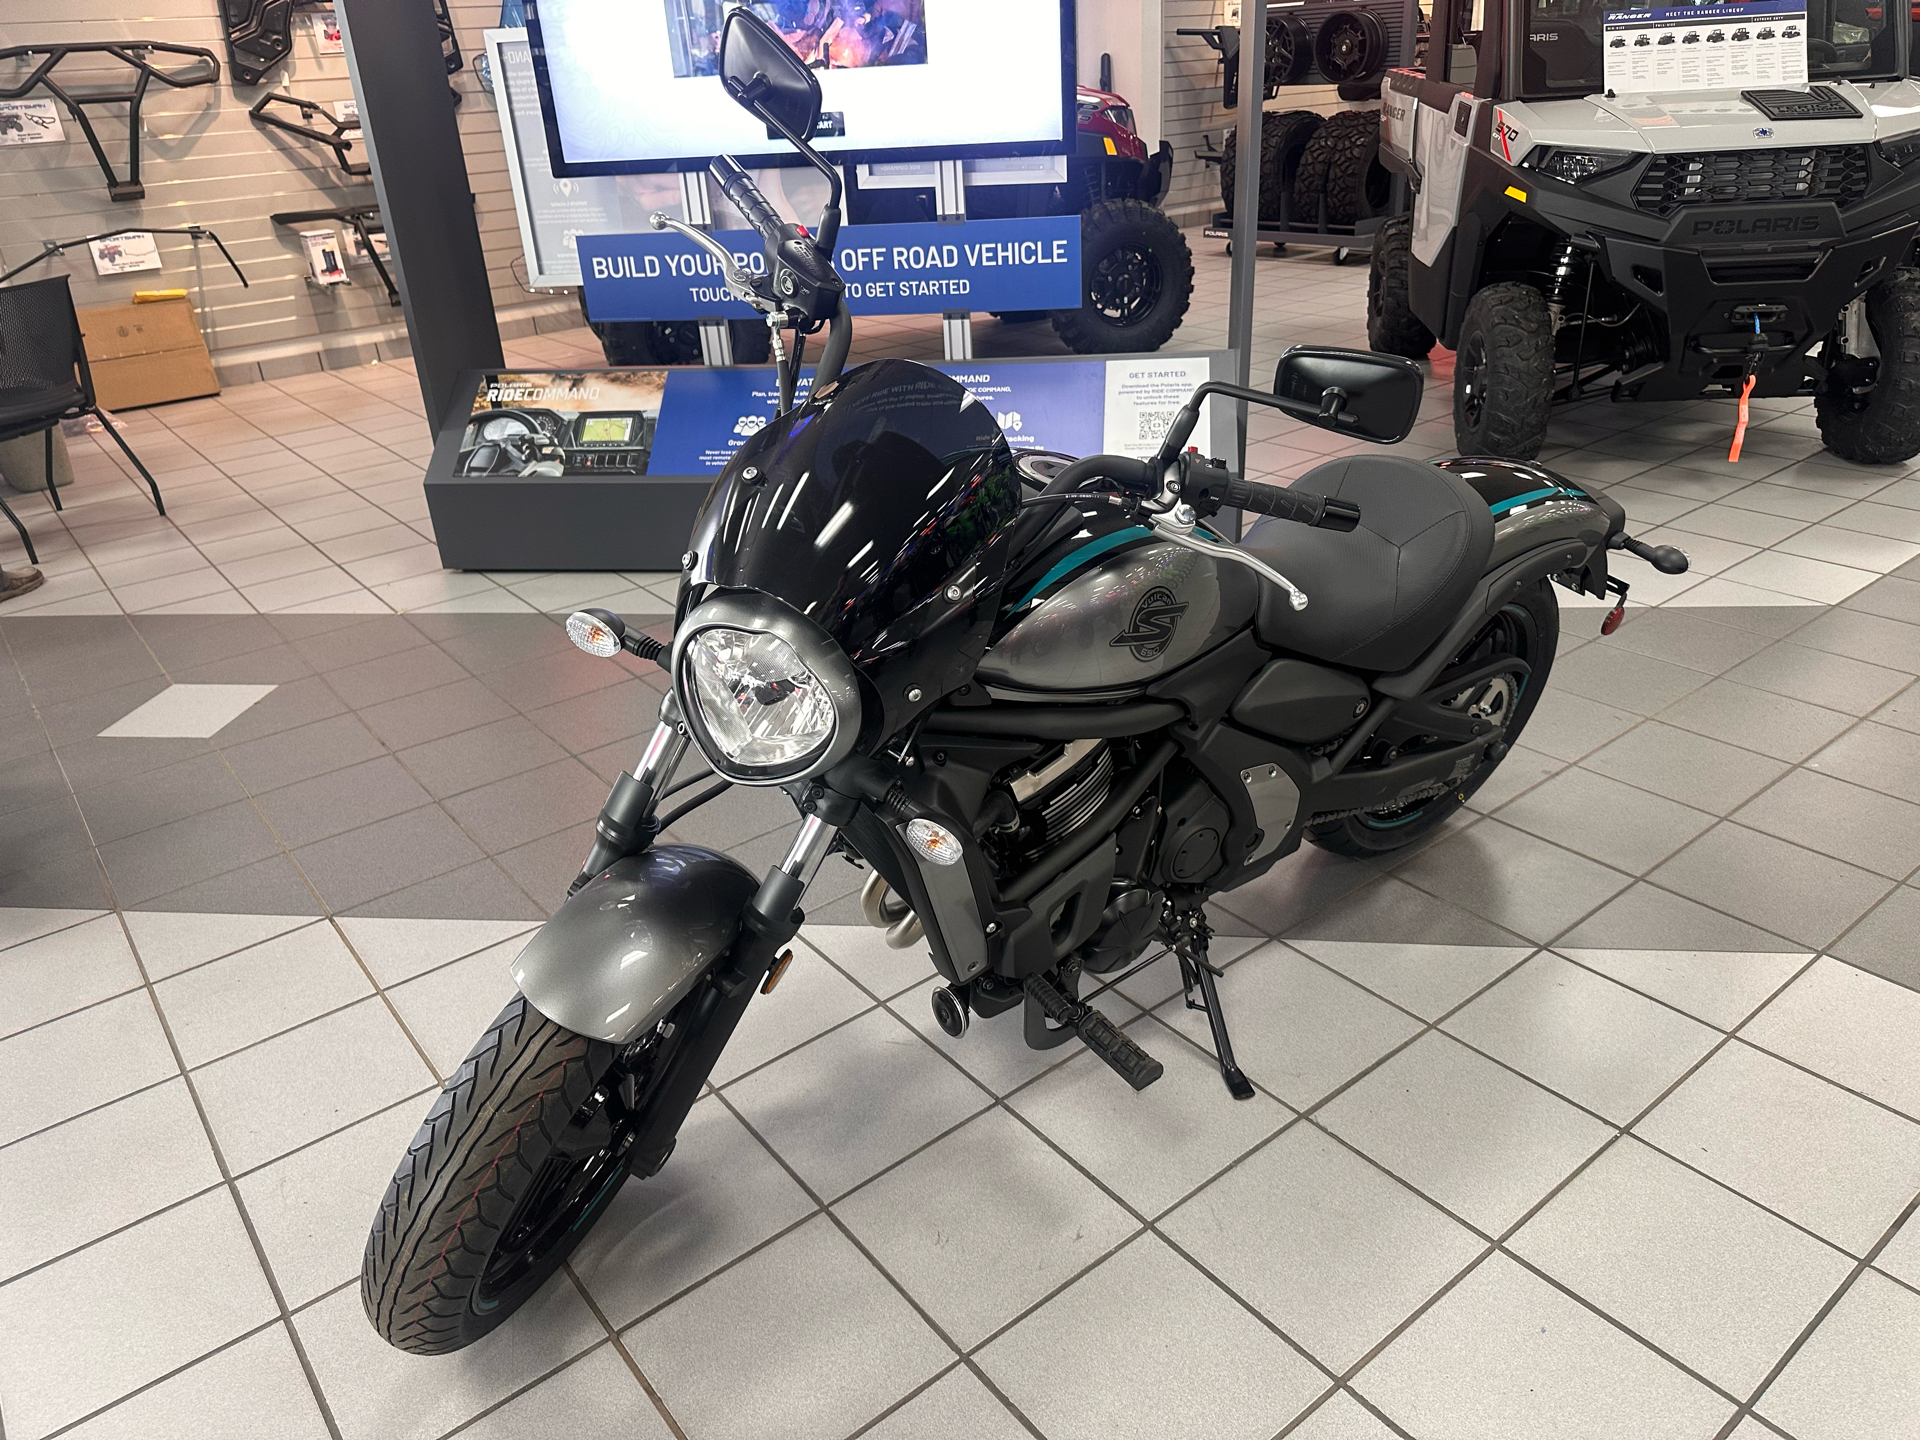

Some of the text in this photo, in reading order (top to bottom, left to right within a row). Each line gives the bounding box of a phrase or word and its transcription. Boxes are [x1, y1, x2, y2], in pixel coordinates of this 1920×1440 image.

[1529, 33, 1559, 41] ARIS
[816, 120, 833, 129] ART
[1495, 120, 1520, 142] 570
[1692, 215, 1820, 236] POLARIS
[592, 256, 661, 279] BUILD
[840, 248, 886, 272] OFF
[892, 245, 959, 270] ROAD
[964, 240, 1068, 267] VEHICLE
[844, 283, 862, 298] TO
[865, 281, 896, 298] GET
[898, 279, 971, 297] STARTED
[1147, 371, 1187, 379] STARTED
[1141, 593, 1172, 609] Vulcan
[1140, 646, 1160, 657] 650
